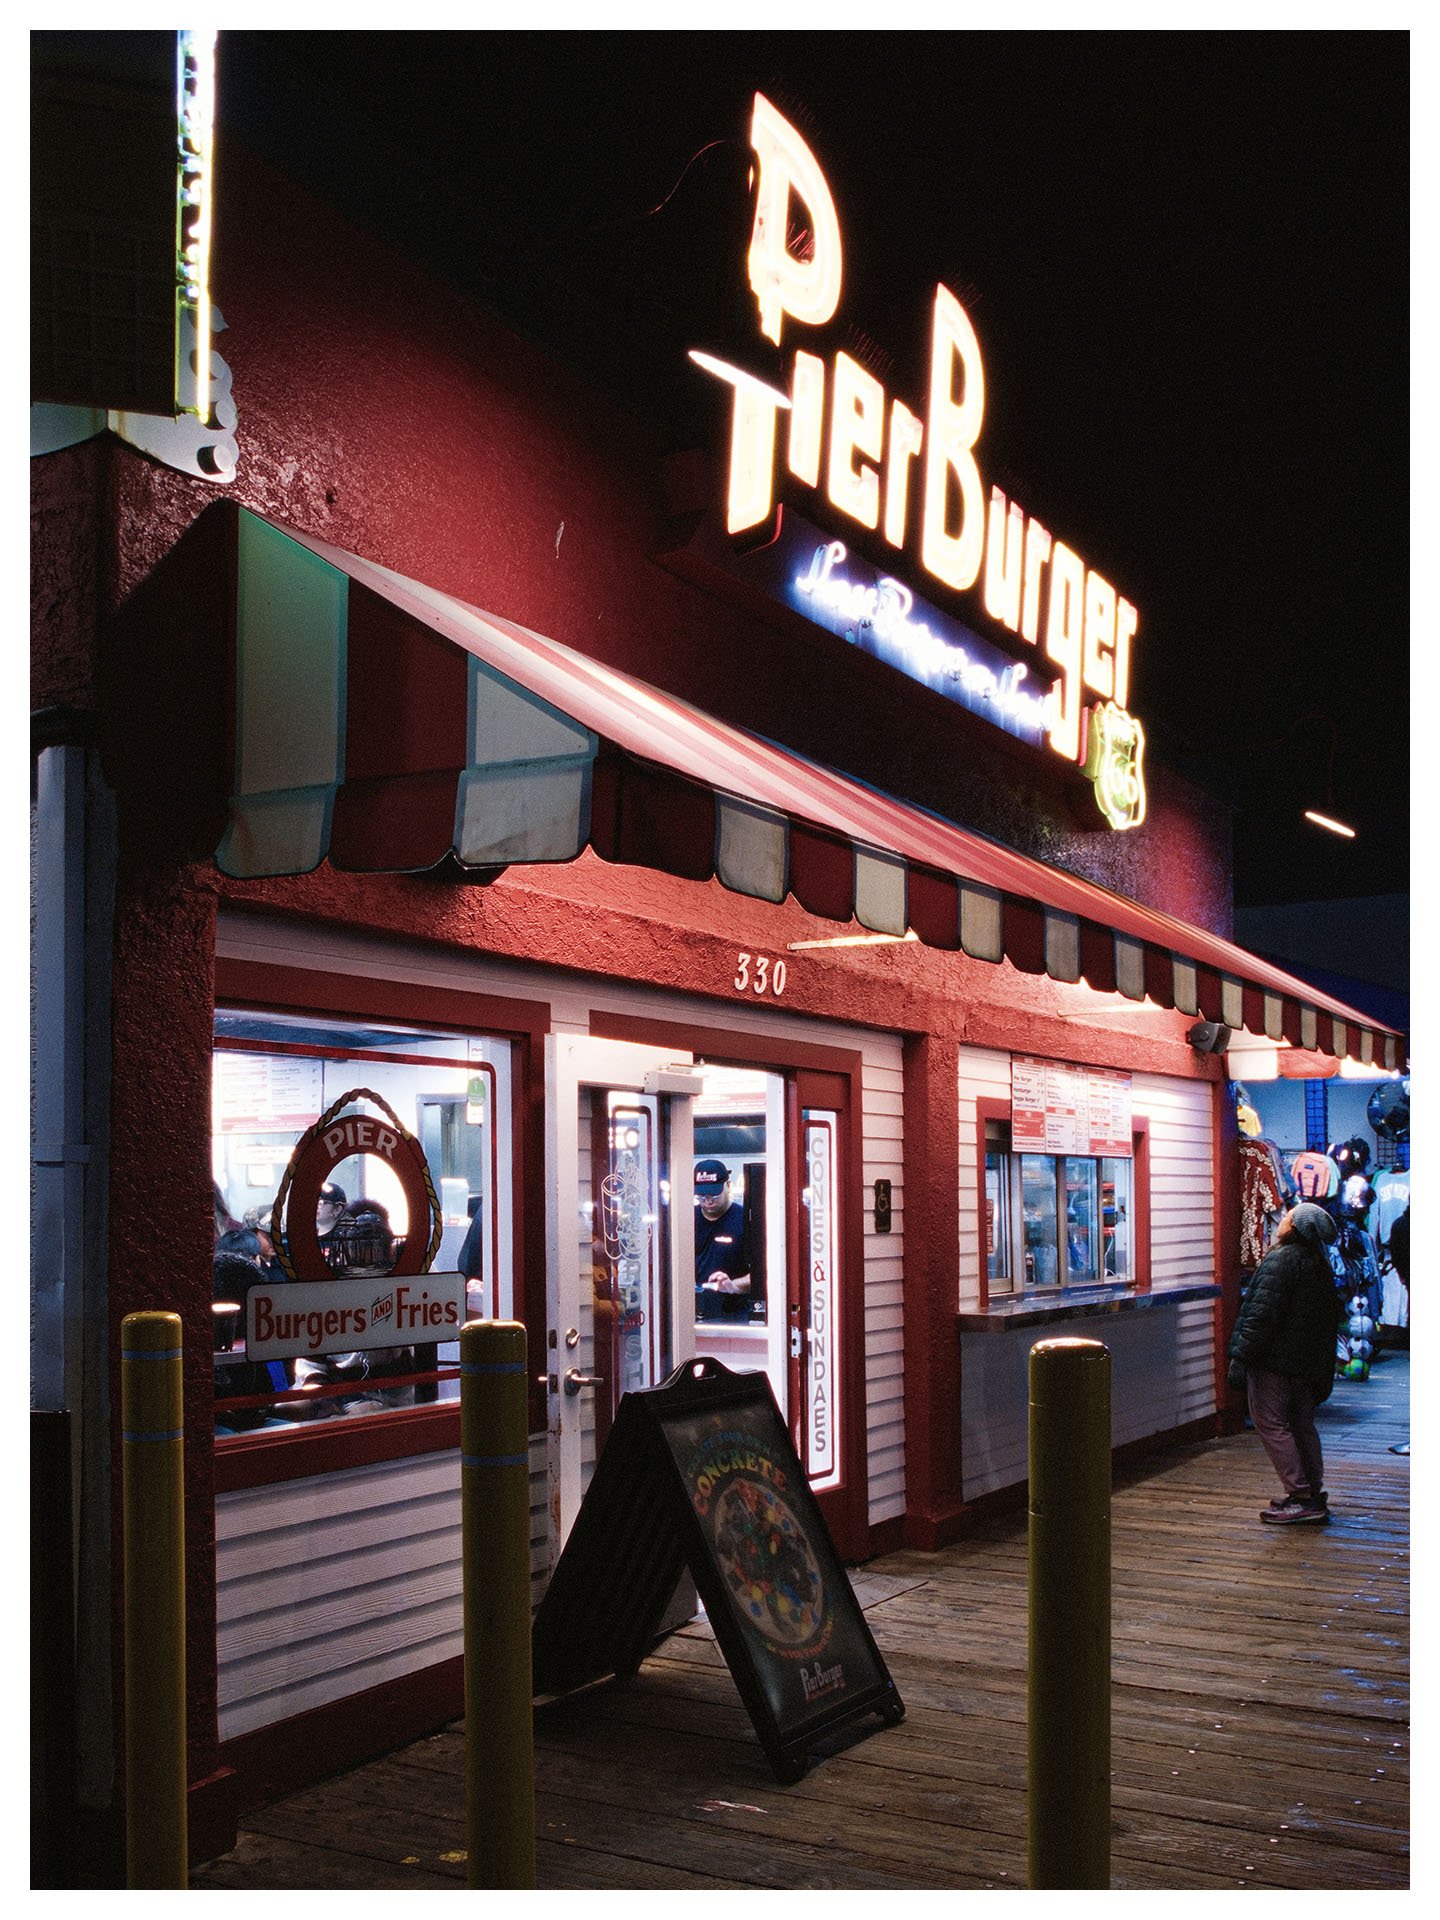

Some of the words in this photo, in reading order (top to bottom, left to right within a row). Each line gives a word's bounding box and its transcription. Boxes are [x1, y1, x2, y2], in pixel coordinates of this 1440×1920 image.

[734, 952, 787, 996] 330
[322, 1121, 398, 1159] PIER
[811, 1136, 824, 1254] CONES
[813, 1260, 826, 1283] &
[254, 1296, 367, 1349] Burgers
[373, 1299, 392, 1322] AND
[396, 1287, 459, 1330] Fries
[813, 1289, 827, 1453] SUNDAES
[694, 1449, 787, 1516] CONCRETE
